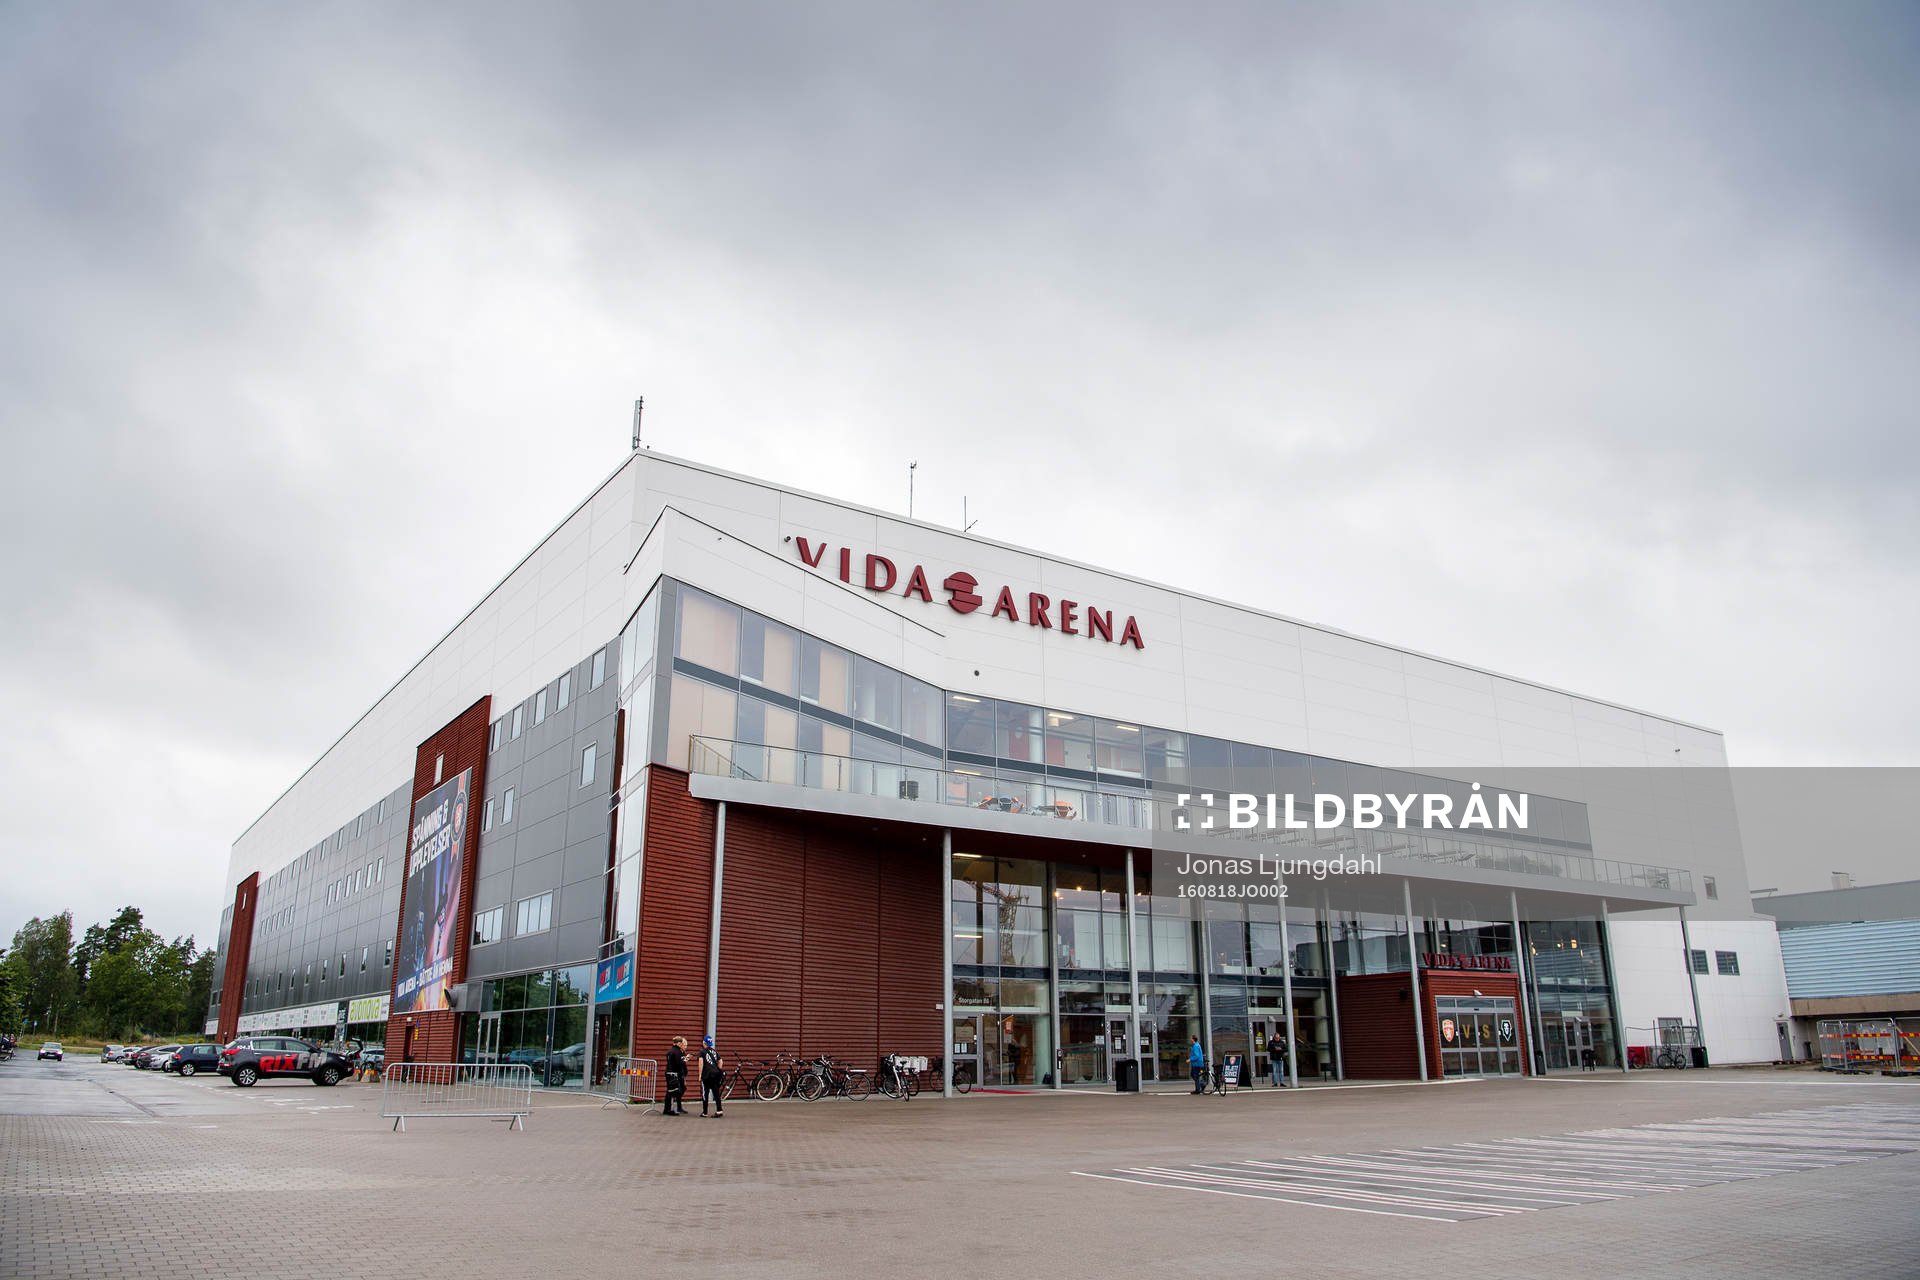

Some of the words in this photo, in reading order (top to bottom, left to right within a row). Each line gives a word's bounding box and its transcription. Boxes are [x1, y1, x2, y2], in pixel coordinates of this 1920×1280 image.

[796, 536, 932, 603] VIDA
[991, 585, 1144, 649] ARENA
[1422, 952, 1457, 968] VIDA
[1470, 954, 1511, 969] ARENA
[350, 998, 381, 1021] avonova
